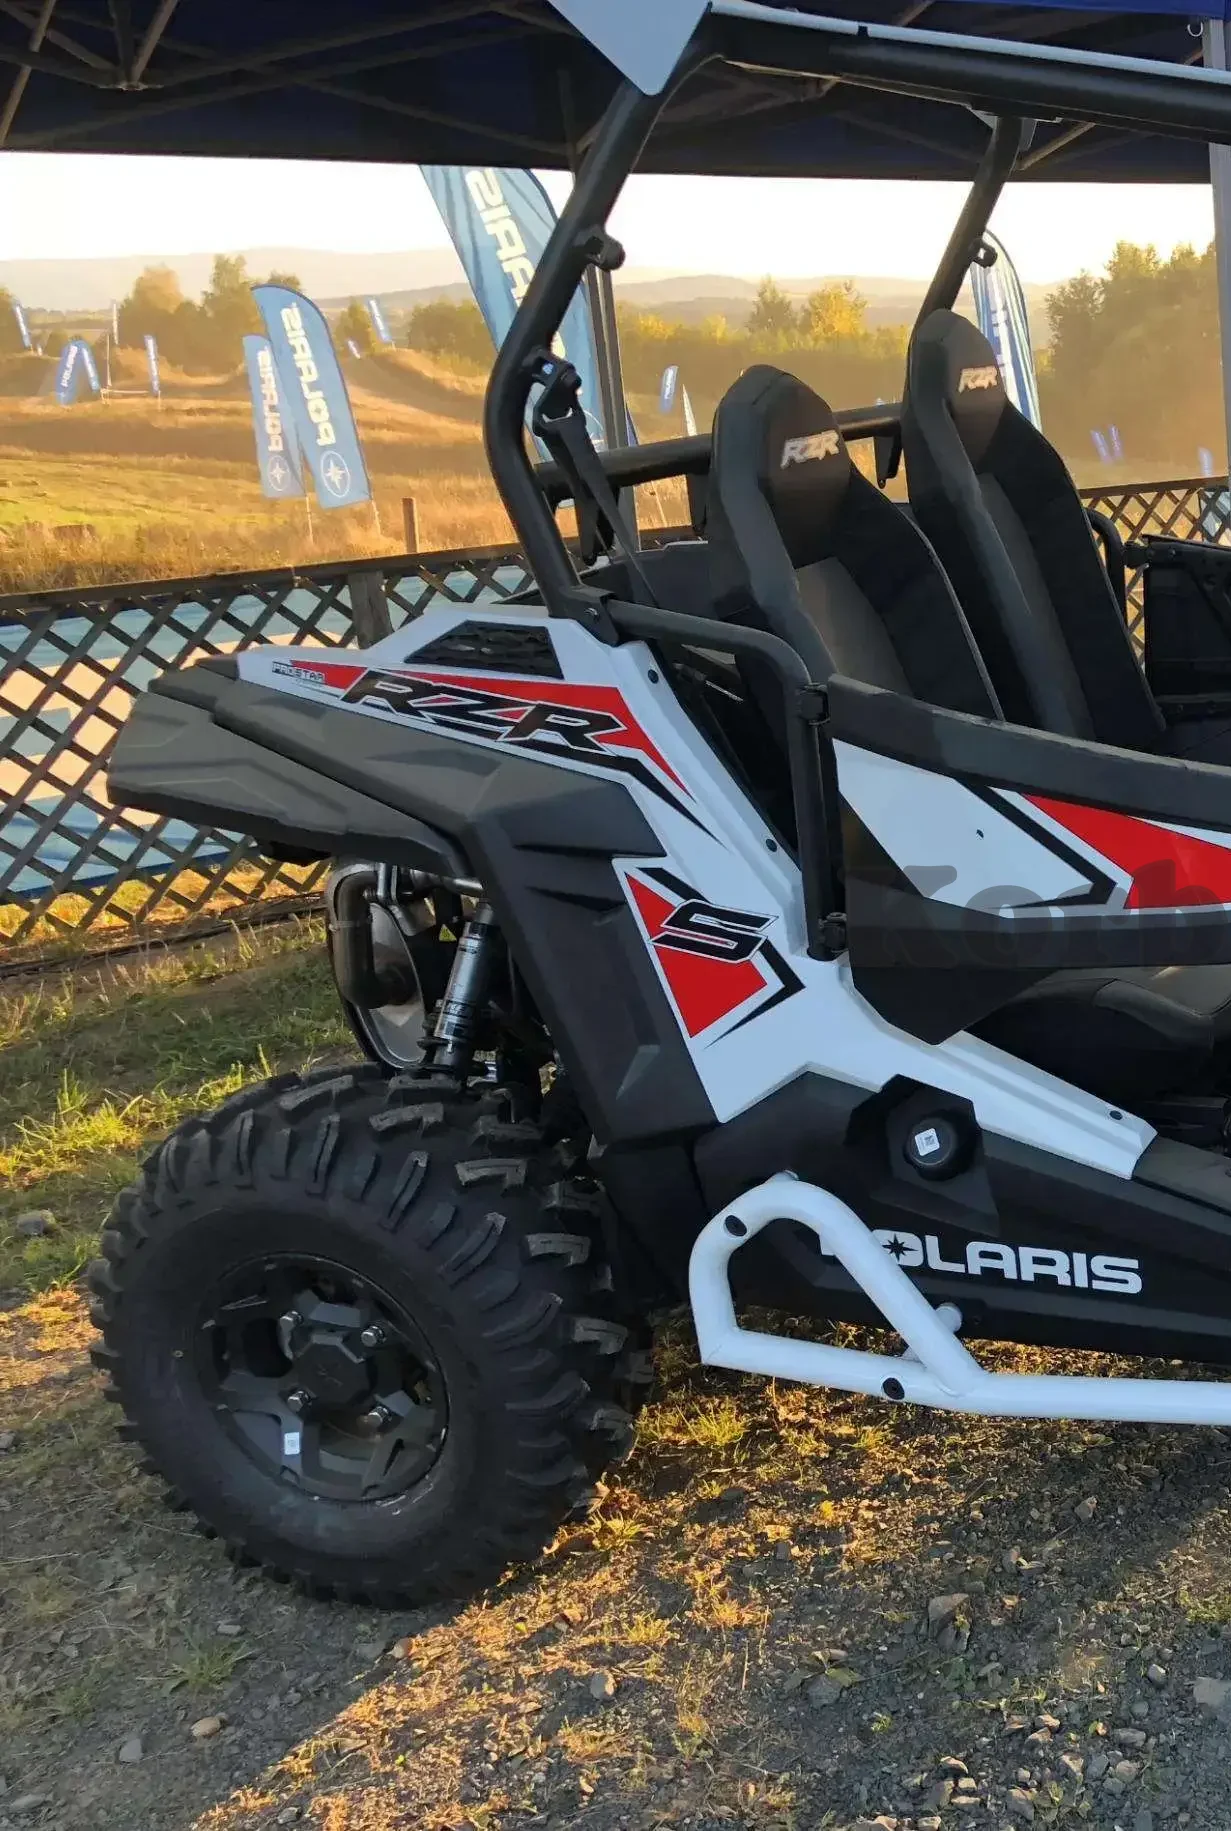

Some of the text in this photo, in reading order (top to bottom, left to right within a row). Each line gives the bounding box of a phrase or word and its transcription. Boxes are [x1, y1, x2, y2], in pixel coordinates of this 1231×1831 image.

[957, 365, 998, 393] RZR
[780, 429, 840, 469] RZR
[339, 668, 628, 757] RZR
[652, 899, 779, 964] S
[820, 1228, 1142, 1294] OLARIS
